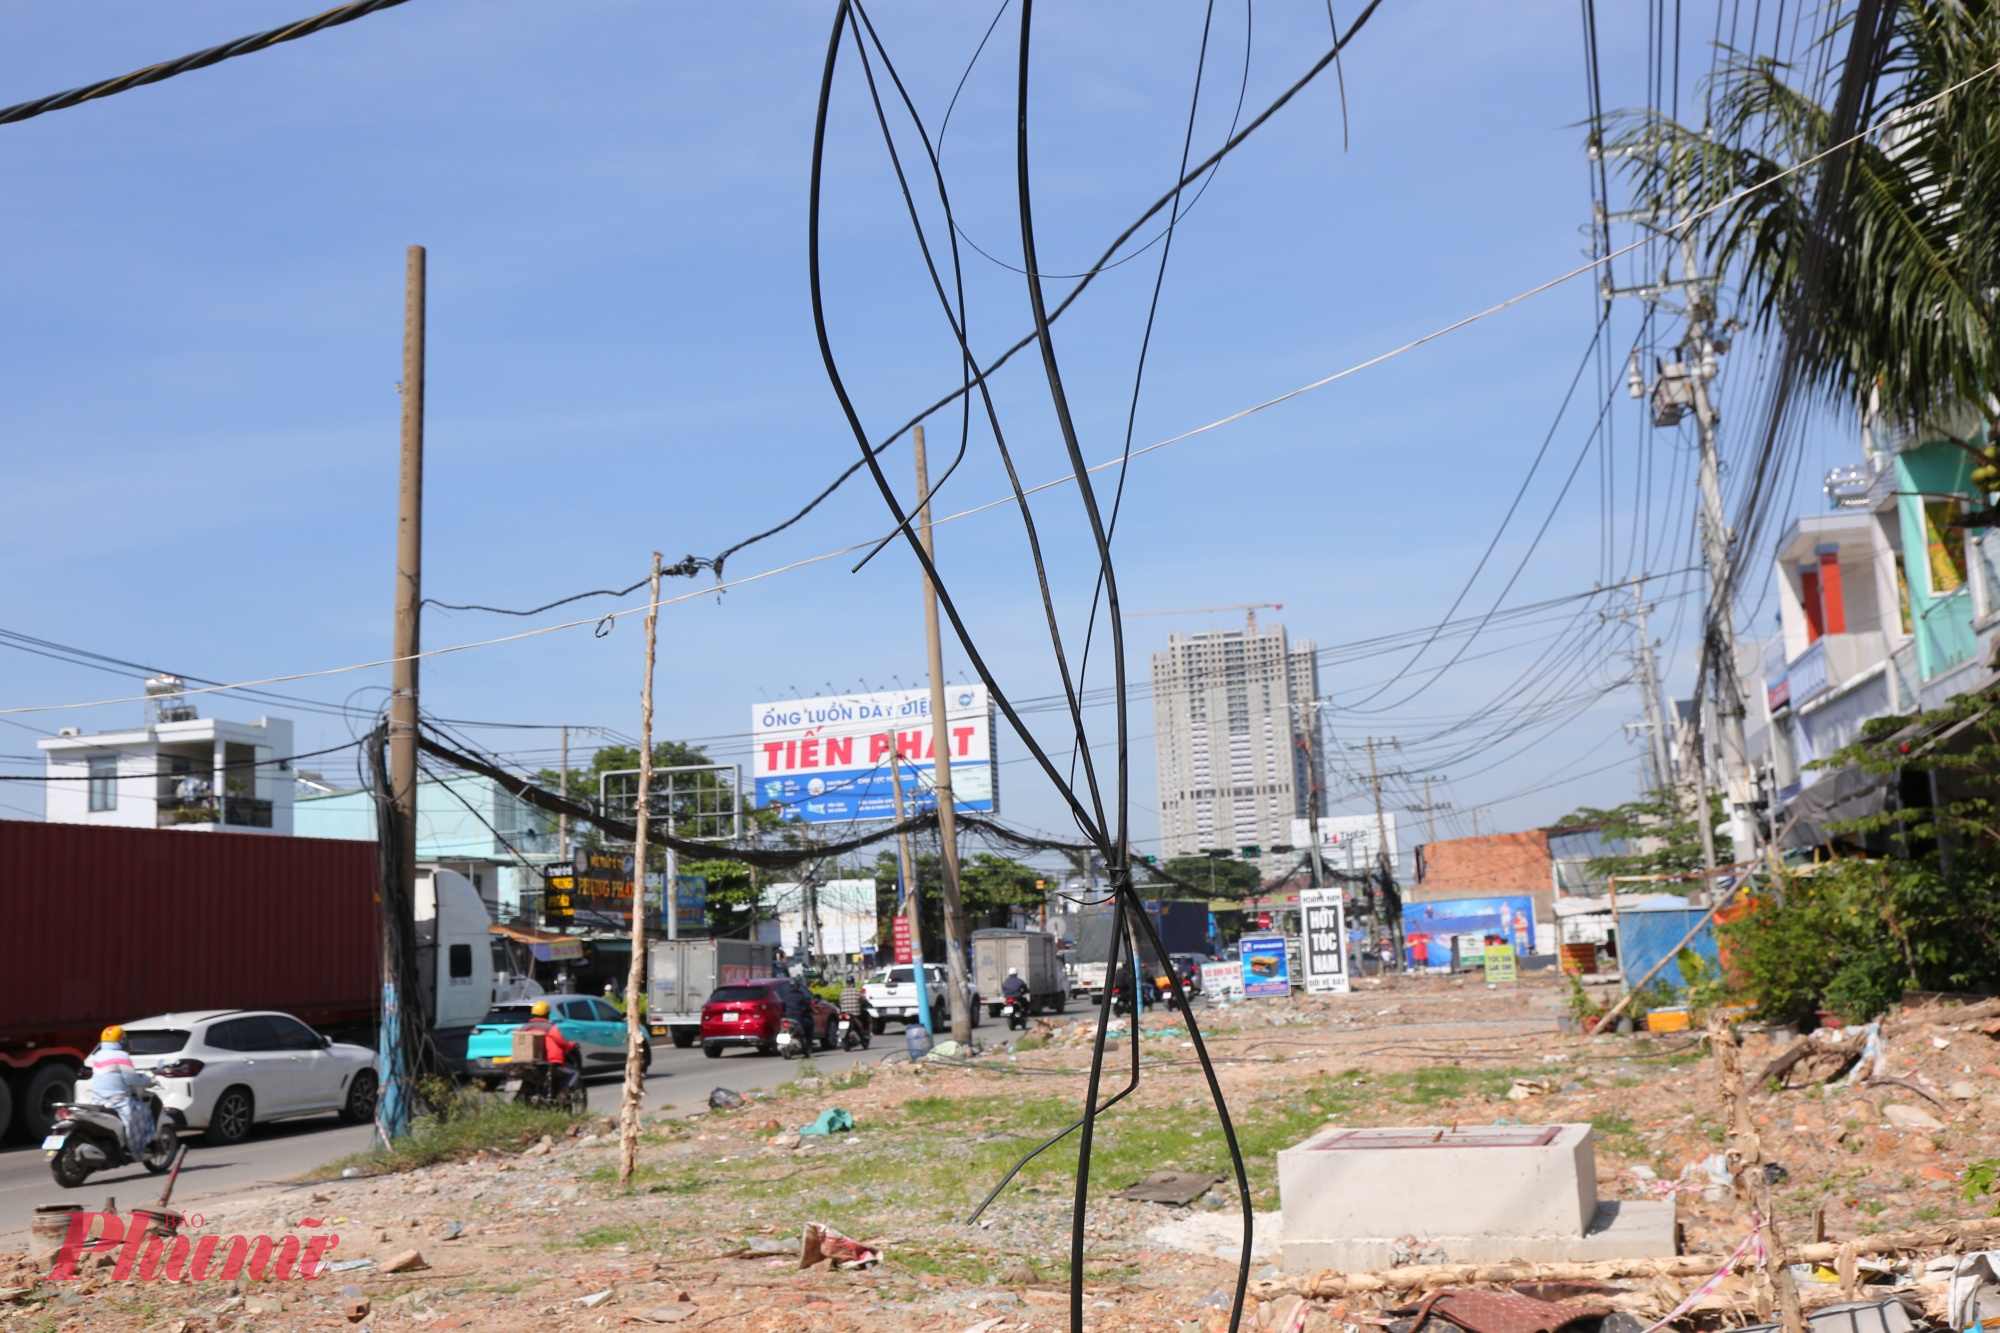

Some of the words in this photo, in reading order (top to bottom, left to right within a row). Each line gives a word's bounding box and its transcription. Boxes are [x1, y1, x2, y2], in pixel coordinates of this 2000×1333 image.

[808, 702, 852, 723] LUỒN
[901, 697, 932, 717] ĐIỆ
[763, 725, 853, 771] TIẾN
[1309, 906, 1335, 929] HỚT
[1311, 929, 1338, 951] TÓC
[1312, 953, 1339, 973] NAM
